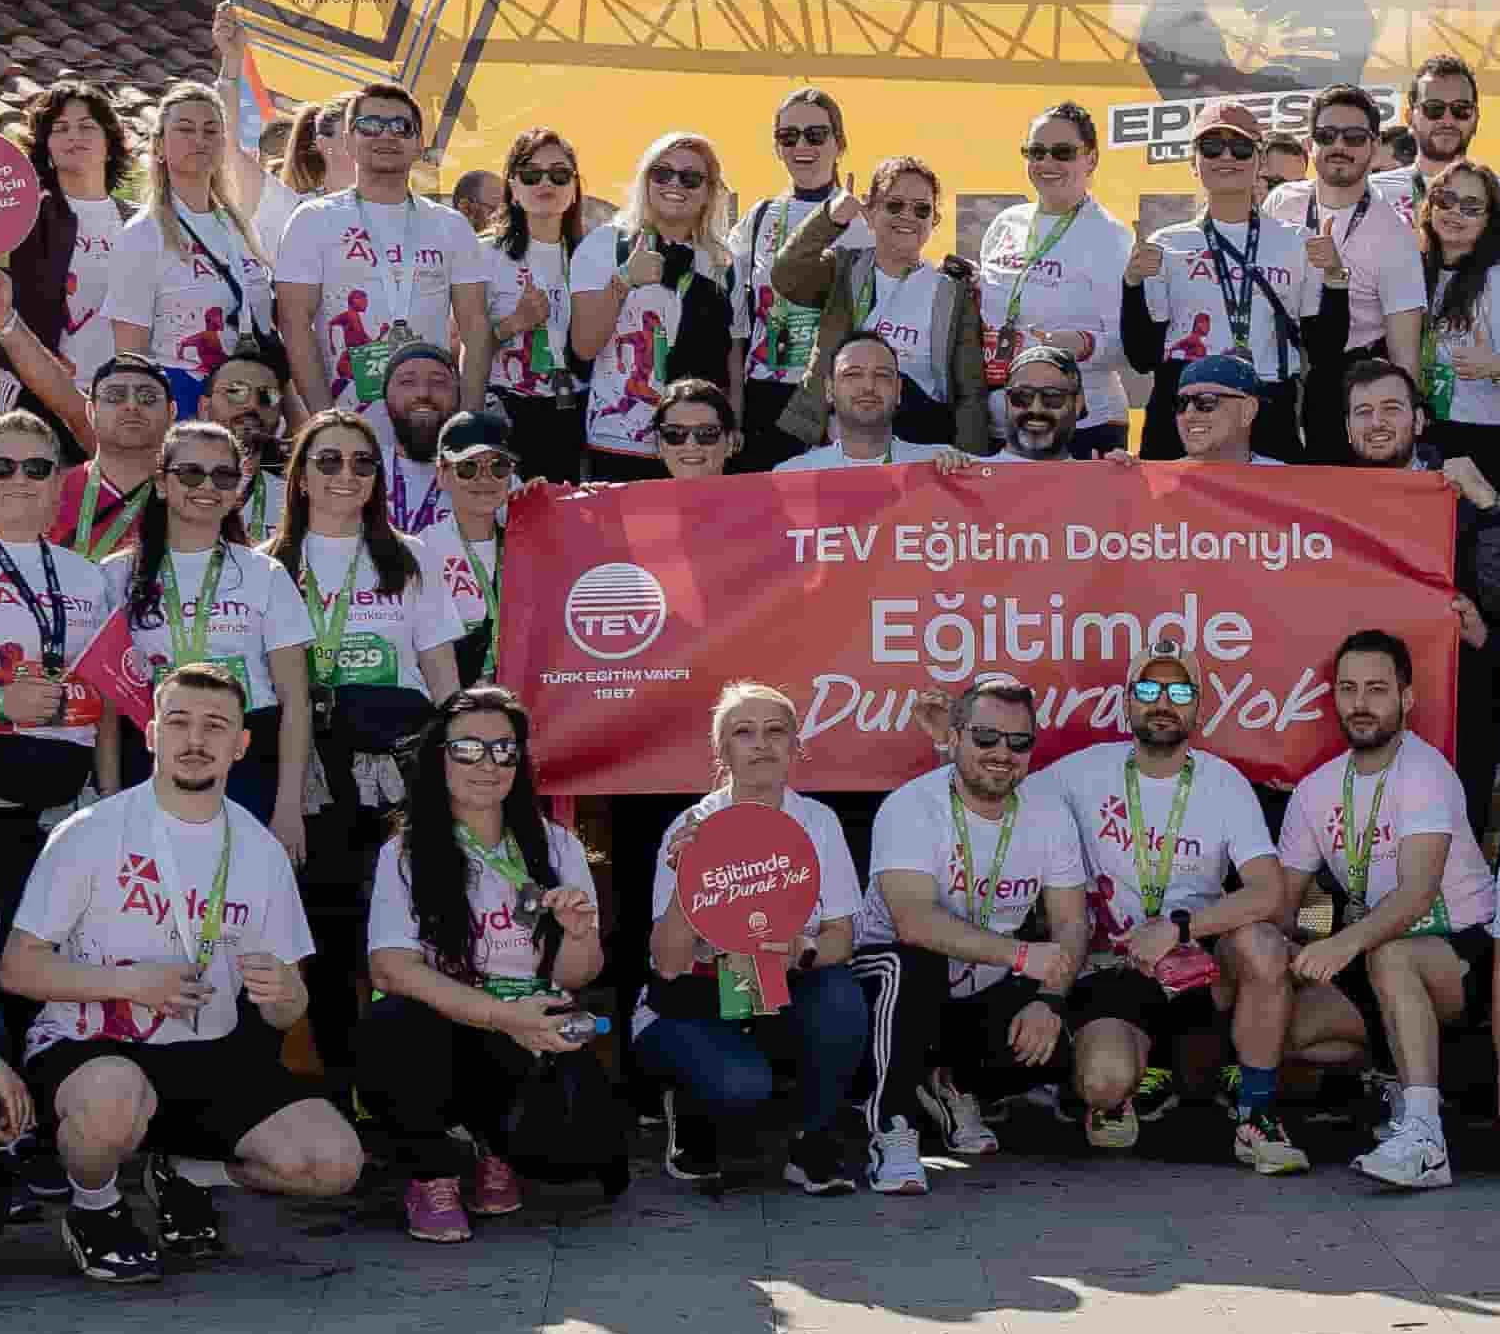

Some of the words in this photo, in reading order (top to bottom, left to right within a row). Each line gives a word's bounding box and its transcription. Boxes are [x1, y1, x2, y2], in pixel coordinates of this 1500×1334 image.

[785, 524, 878, 563] TEV
[894, 522, 1050, 572] Eğitim
[1064, 521, 1334, 572] Dostlarıyla
[577, 613, 654, 636] TEV
[870, 592, 1254, 682] Eğitimde
[336, 648, 385, 669] 629
[539, 668, 583, 683] TÜRK
[585, 666, 642, 683] EĞİTİM
[1202, 667, 1331, 737] Yok
[701, 850, 791, 891] Eğitimde
[690, 887, 724, 914] Dur
[727, 873, 779, 904] Durak
